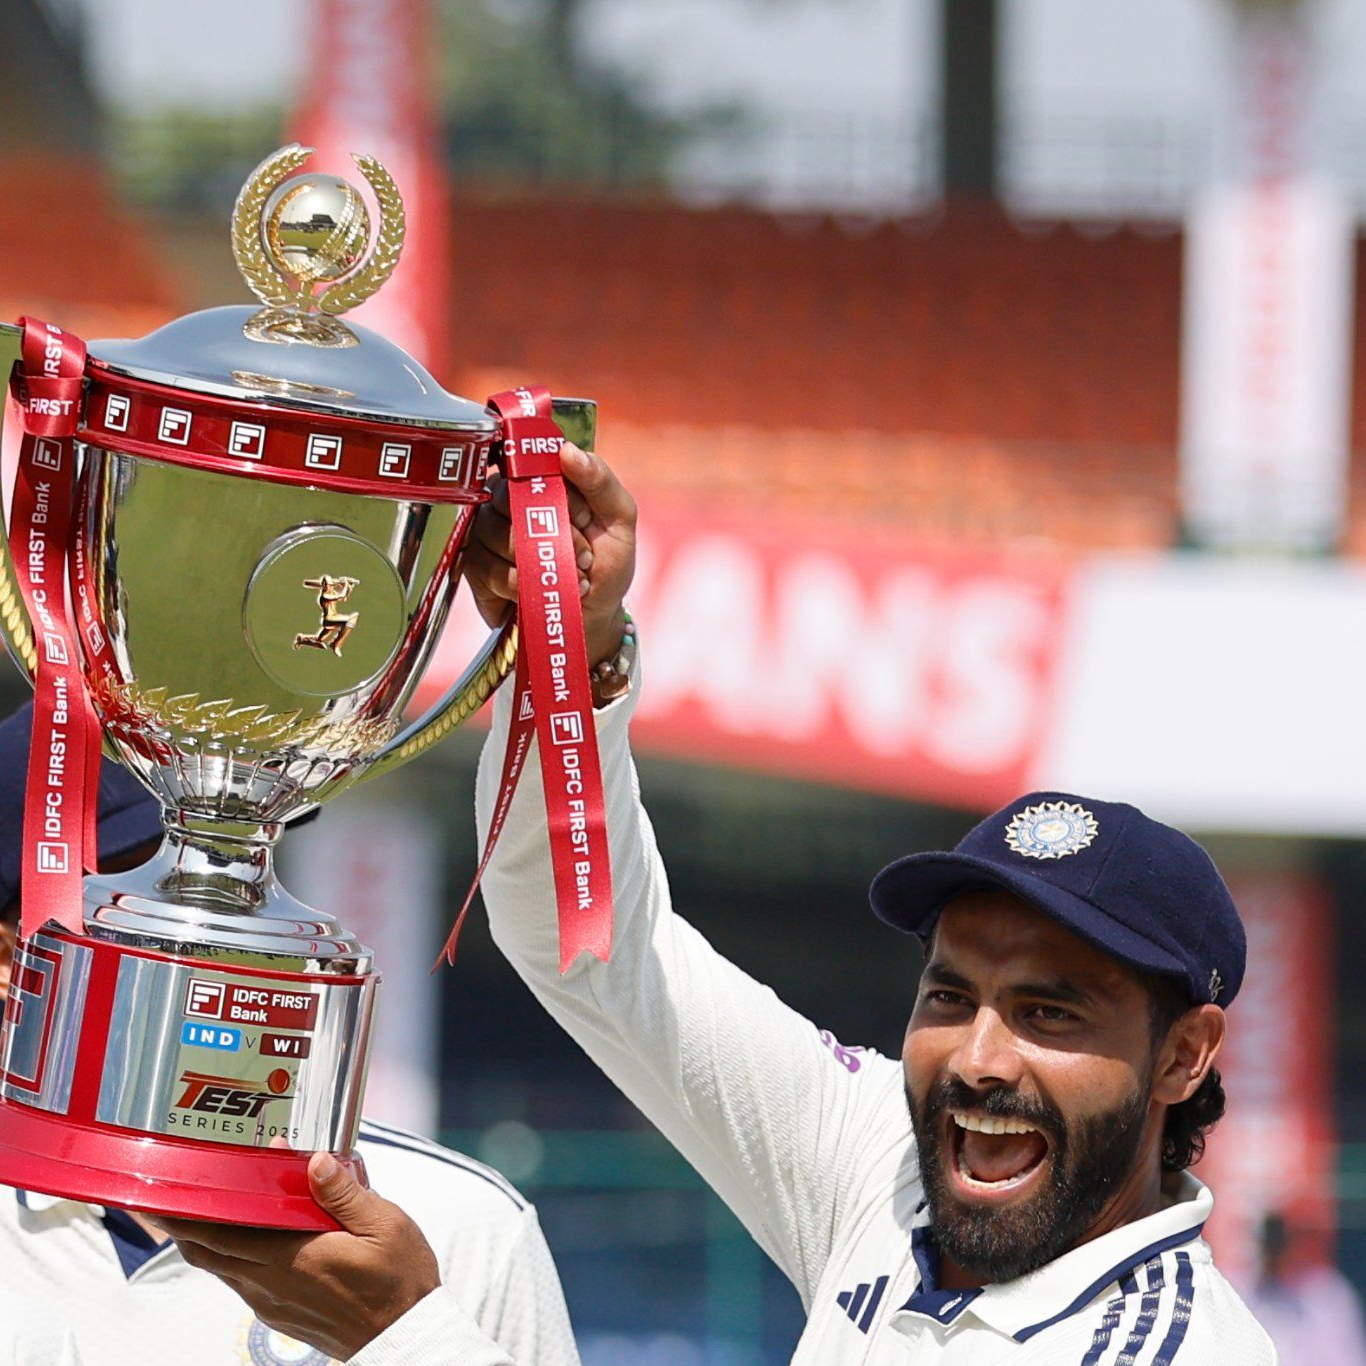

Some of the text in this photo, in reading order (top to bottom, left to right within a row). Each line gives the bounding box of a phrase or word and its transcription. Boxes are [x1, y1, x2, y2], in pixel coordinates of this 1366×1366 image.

[44, 333, 63, 378] IRST
[29, 398, 74, 416] FIRST
[515, 391, 537, 417] FIR
[521, 437, 565, 454] FIRST
[32, 481, 51, 524] Bank
[29, 528, 46, 584] FIRST
[537, 541, 558, 586] IDFC
[31, 588, 55, 631] IDFC
[543, 590, 565, 648] FIRST
[53, 676, 68, 724] Bank
[550, 653, 570, 702] Bank
[48, 729, 66, 787] FIRST
[562, 748, 583, 795] IDFC
[45, 792, 62, 838] IDFC
[568, 799, 589, 856] FIRST
[574, 860, 595, 910] Bank
[230, 1006, 268, 1022] Bank
[233, 989, 269, 1005] IDFC
[272, 994, 312, 1009] FIRST
[189, 1027, 233, 1046] IND
[273, 1039, 300, 1054] WI
[175, 1070, 290, 1118] TEST
[168, 1112, 299, 1139] SERIES 2025
